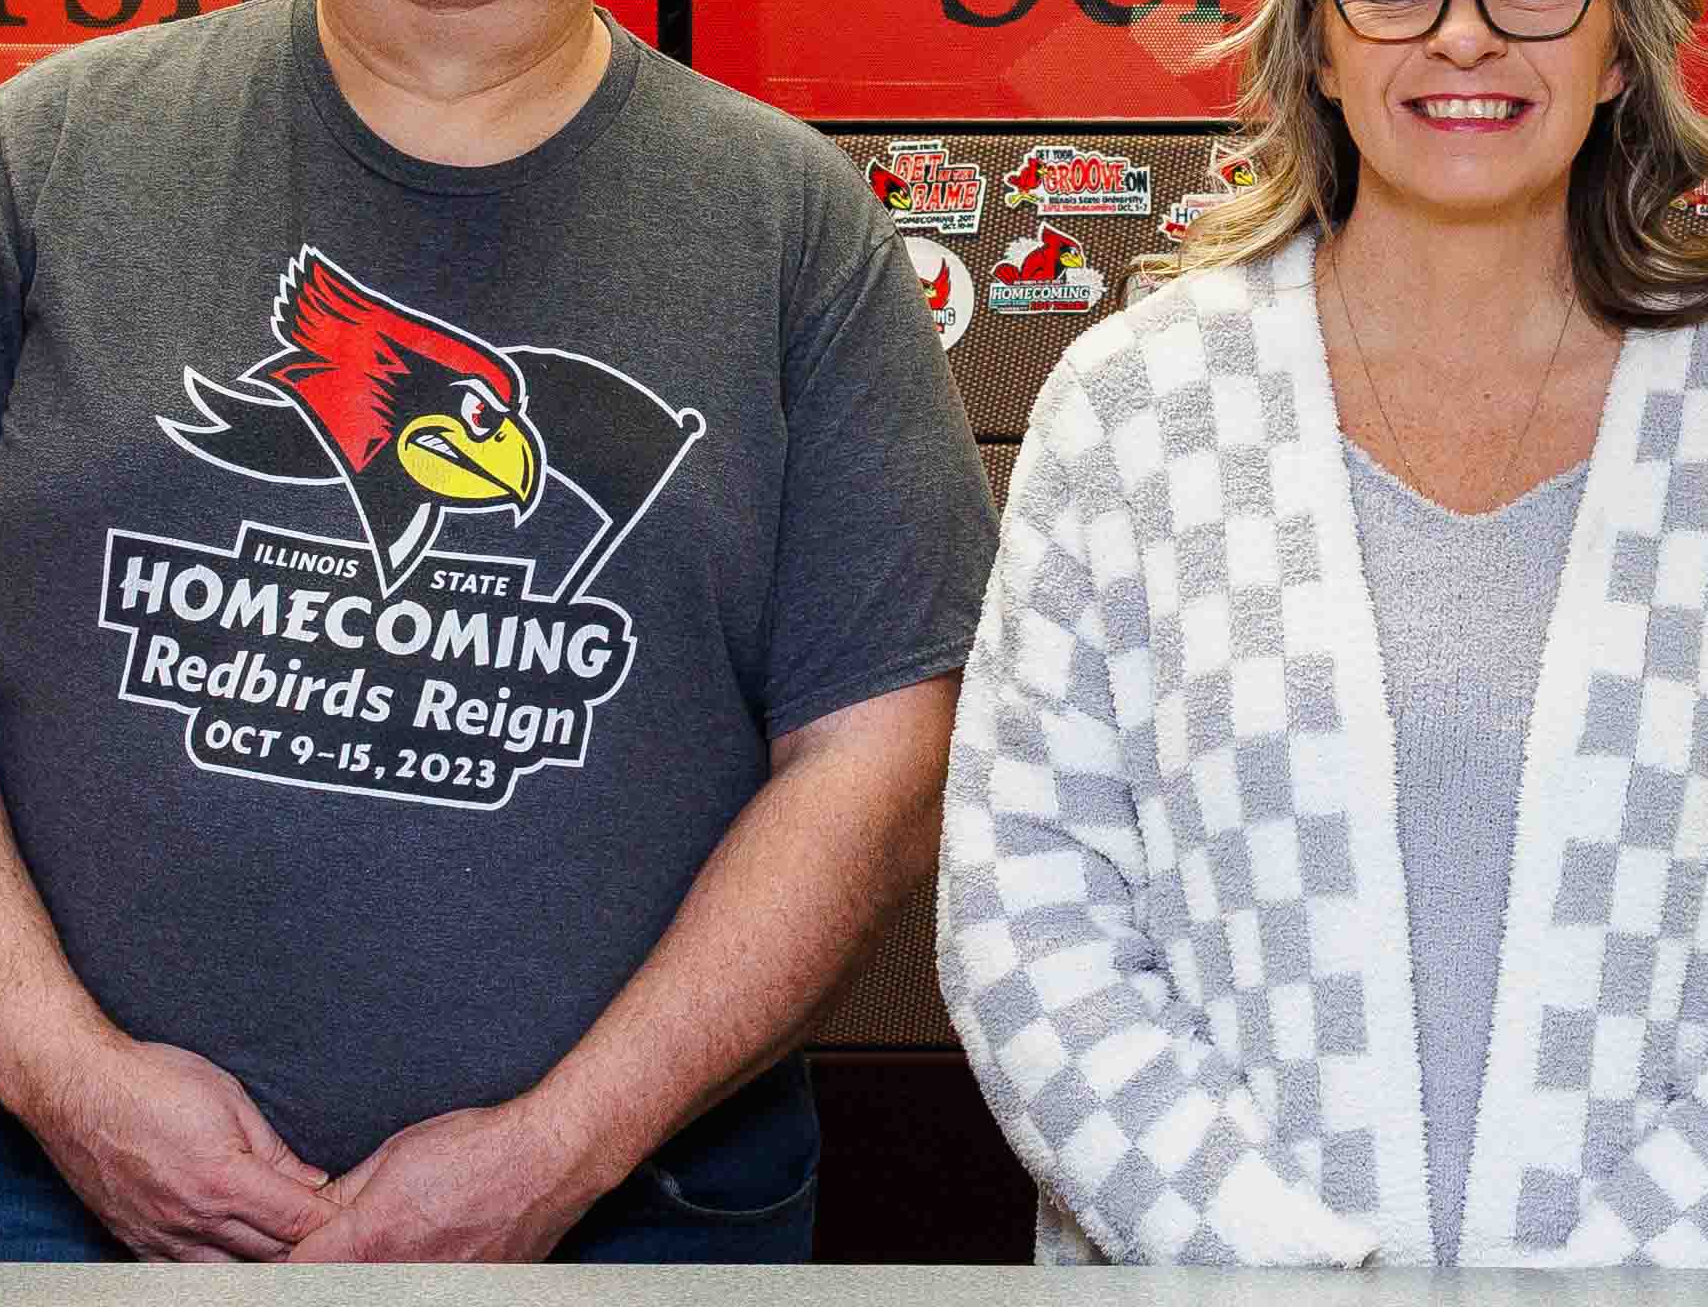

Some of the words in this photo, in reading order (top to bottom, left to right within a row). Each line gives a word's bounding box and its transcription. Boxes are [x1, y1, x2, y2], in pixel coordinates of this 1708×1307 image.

[895, 153, 945, 183] GET
[1043, 156, 1125, 194] GROOVE
[1124, 170, 1148, 194] ON
[912, 182, 980, 211] GAME
[992, 286, 1090, 301] HOMECOMING
[253, 543, 360, 579] ILLINOIS
[430, 570, 511, 597] STATE
[119, 556, 613, 679] HOMECOMING
[141, 634, 395, 722] Redbirds
[412, 678, 575, 753] Reign
[205, 719, 283, 758] OCT
[395, 749, 496, 789] 2023
